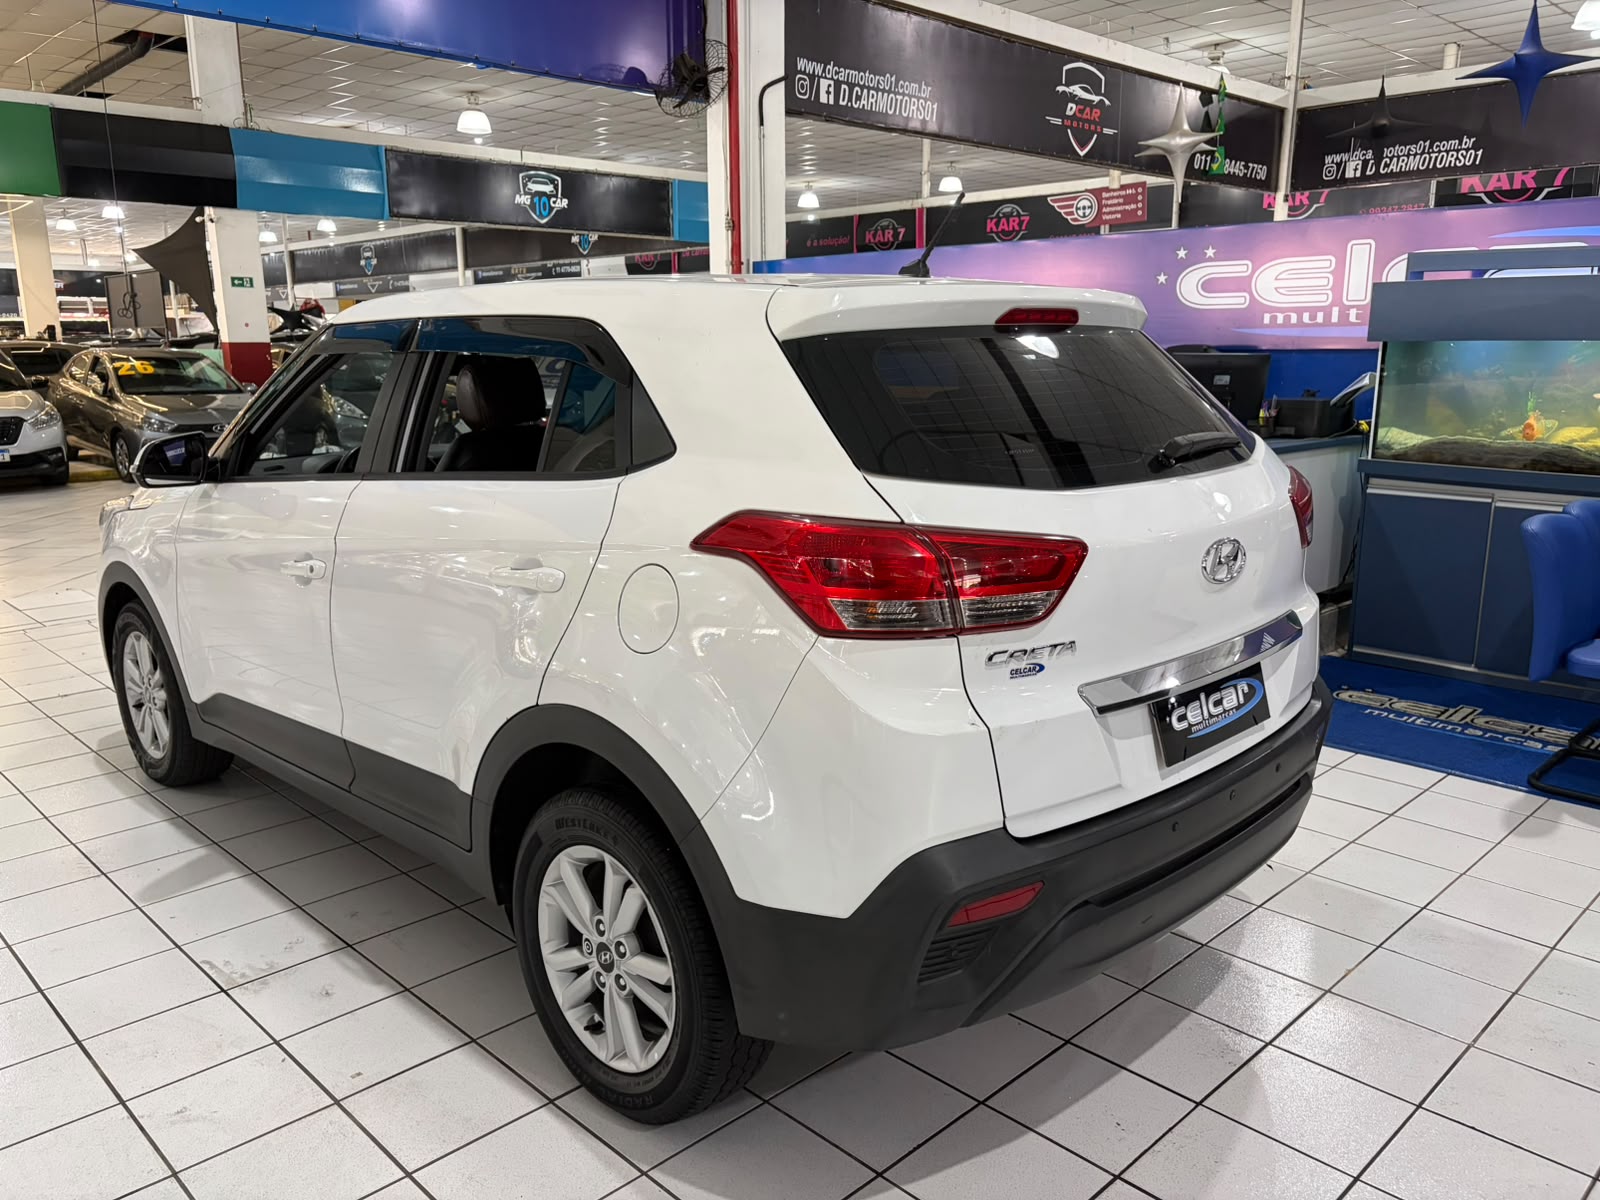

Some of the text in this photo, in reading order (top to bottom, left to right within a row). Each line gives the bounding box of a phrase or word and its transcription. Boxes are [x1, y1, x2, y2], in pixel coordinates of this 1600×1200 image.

[796, 57, 932, 98] www.dcarmotors01.com.br
[839, 84, 938, 122] D.CARMOTORS01
[1065, 102, 1102, 122] DCAR
[1063, 119, 1102, 132] MOTORS
[1325, 135, 1476, 164] www.dcaotors01.com.br
[1193, 153, 1267, 180] 011 8445-7750
[1366, 149, 1483, 176] DCARMOTORS01
[533, 196, 550, 217] 10
[550, 197, 568, 208] CAR
[1263, 190, 1310, 209] KR
[865, 227, 906, 244] KAR 7
[1263, 306, 1363, 325] mult
[112, 360, 156, 376] 26
[985, 639, 1077, 668] CRETA
[1009, 665, 1037, 676] CELCAR
[1171, 681, 1249, 731] celcar
[1191, 708, 1237, 733] multimarcas
